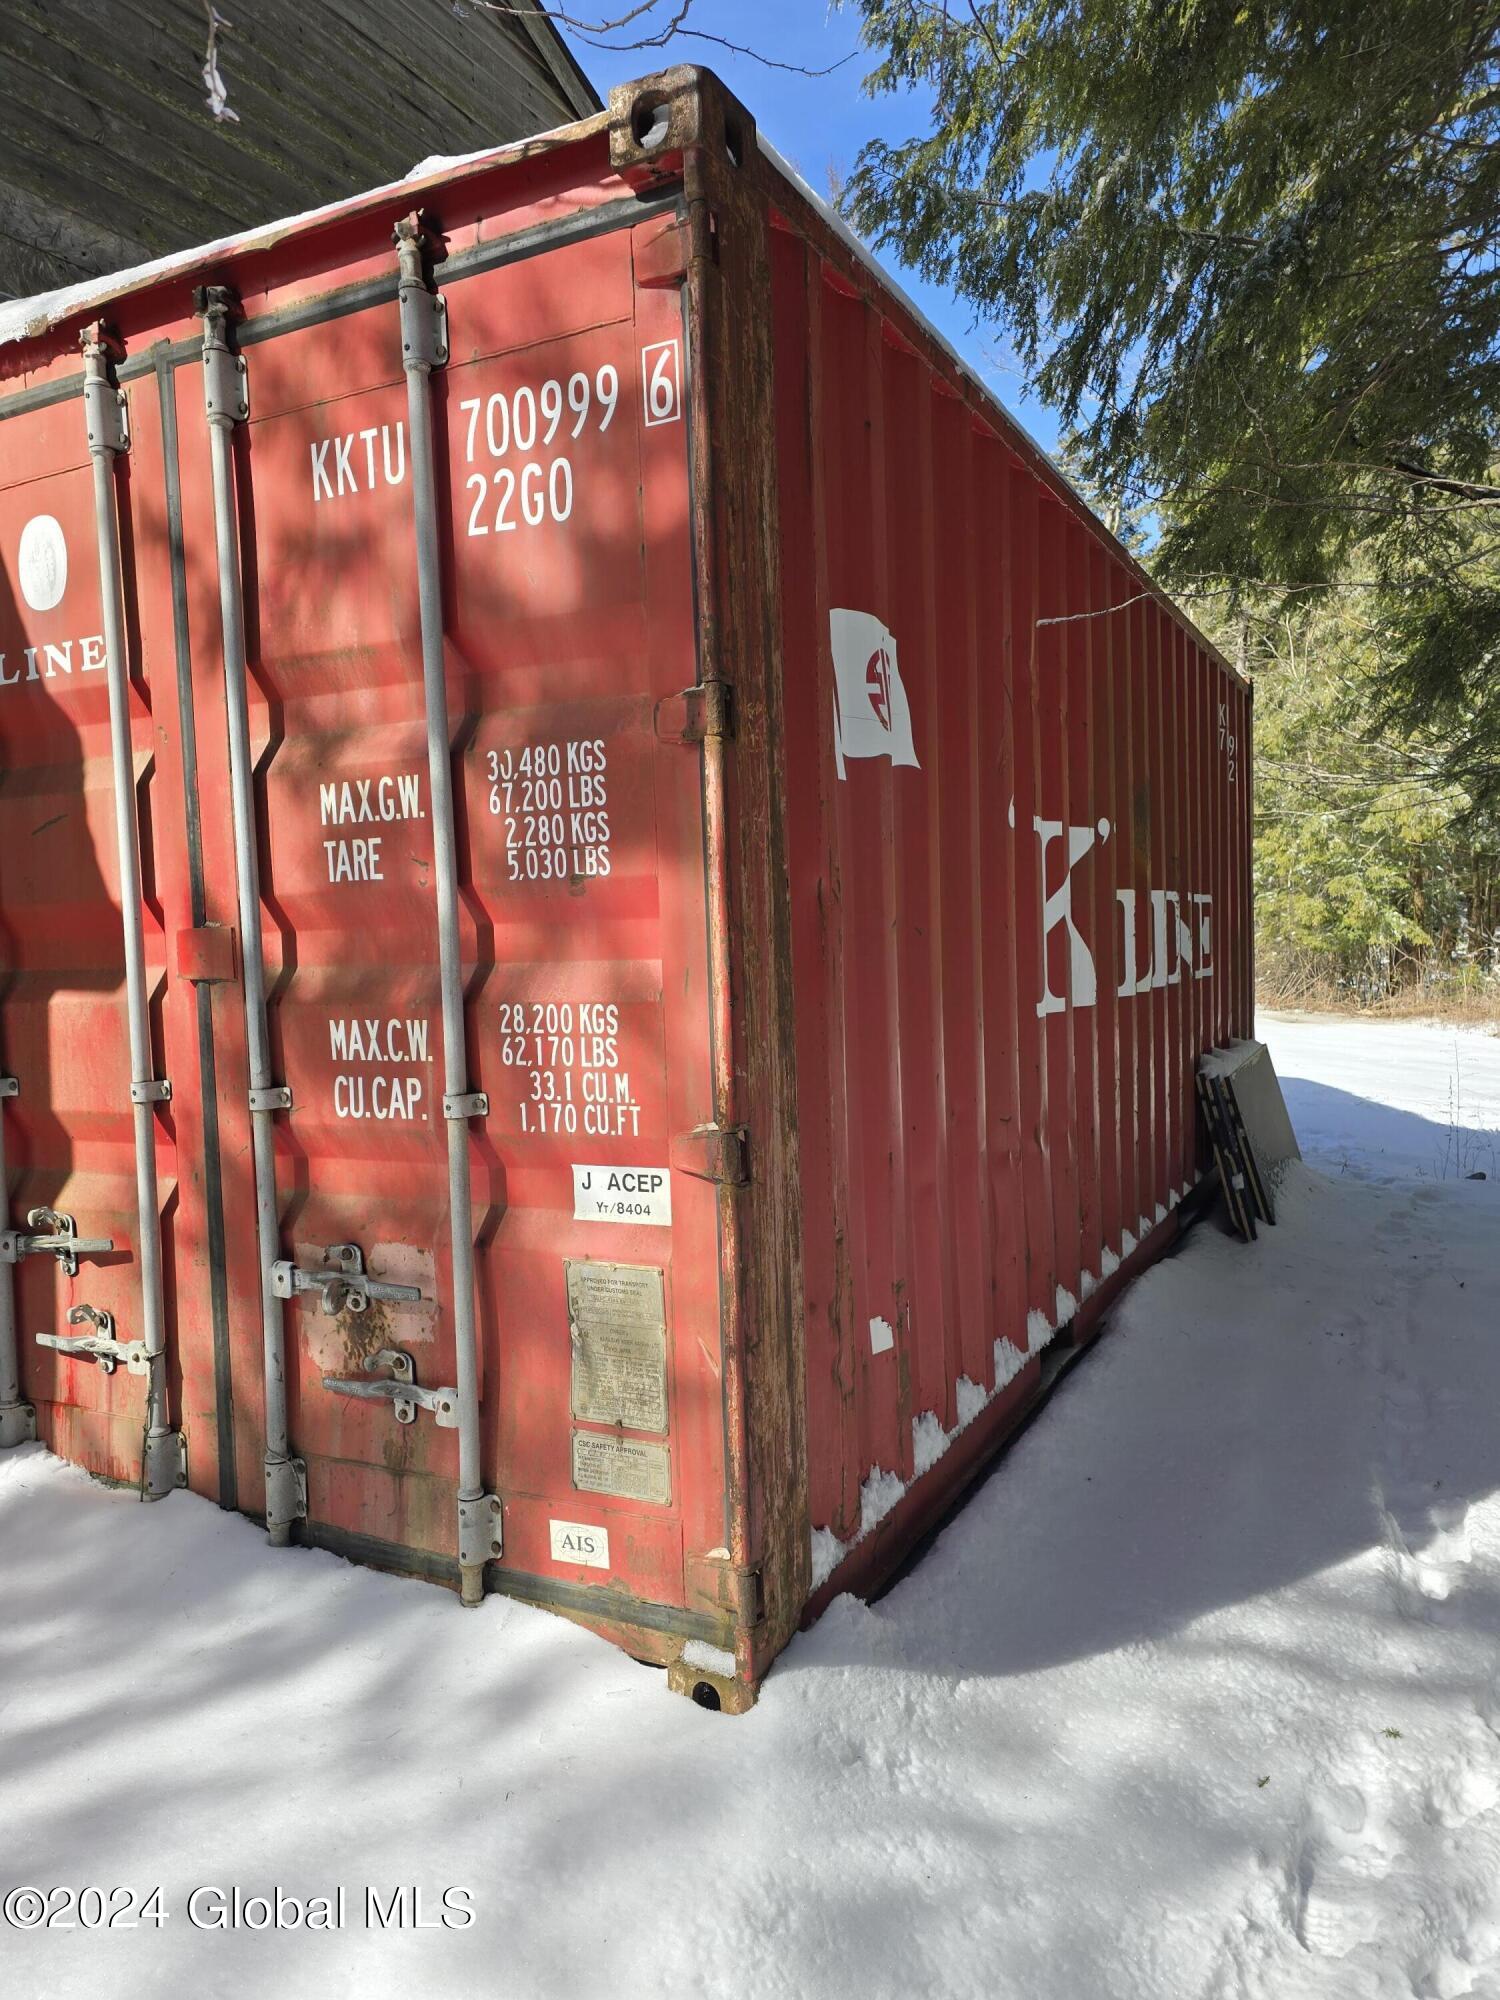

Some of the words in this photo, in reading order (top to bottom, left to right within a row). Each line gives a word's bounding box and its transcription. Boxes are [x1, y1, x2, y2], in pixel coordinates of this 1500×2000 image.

[310, 422, 406, 501] KKTU
[460, 364, 619, 463] 700999
[650, 348, 674, 418] 6
[0, 635, 108, 686] LINE
[567, 739, 607, 774] KGS
[320, 774, 425, 826] MAX.G.W.
[489, 778, 562, 815] 67,200
[569, 775, 607, 808] LBS
[504, 813, 564, 848] 2,280
[571, 811, 610, 845] KGS
[324, 837, 384, 883] TARE
[507, 848, 567, 881] 5,030
[573, 845, 611, 876] LBS
[1116, 889, 1214, 997] LINE
[499, 1003, 573, 1035] 28,200
[580, 1004, 619, 1036] KGS
[329, 1018, 433, 1062] MAX.C.W.
[502, 1036, 574, 1068] 62,170
[581, 1037, 619, 1068] LBS
[334, 1075, 428, 1120] CU.CAP.
[529, 1071, 572, 1102] 33.1
[582, 1071, 636, 1105] CU.M.
[519, 1102, 577, 1134] 1,170
[584, 1105, 641, 1137] CU.FT
[581, 1171, 591, 1190] J
[607, 1172, 663, 1193] ACEP
[578, 1440, 590, 1448] CSC
[591, 1441, 615, 1452] SAFETY
[616, 1446, 648, 1458] APPROVAL
[561, 1534, 595, 1553] AIS
